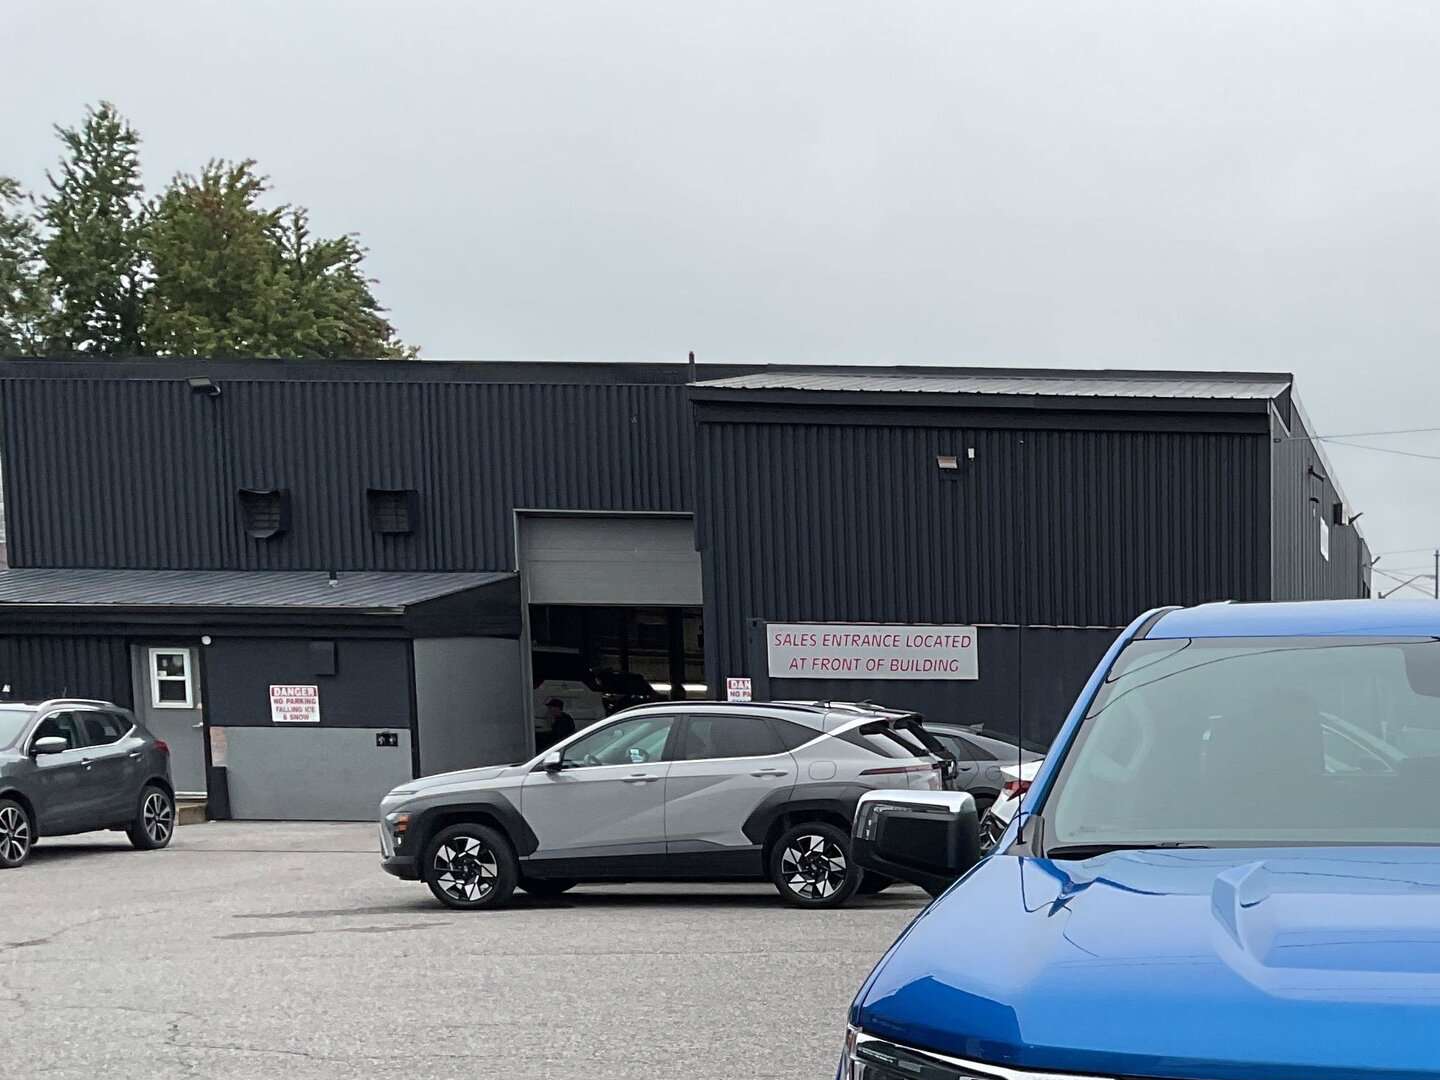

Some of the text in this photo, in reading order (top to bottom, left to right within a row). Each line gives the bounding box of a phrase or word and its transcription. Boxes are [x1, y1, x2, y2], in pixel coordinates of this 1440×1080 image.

[774, 633, 971, 648] SALES ENTRANCE LOCATED
[789, 657, 959, 672] AT FRONT OF BUILDING
[273, 687, 315, 696] DANGER
